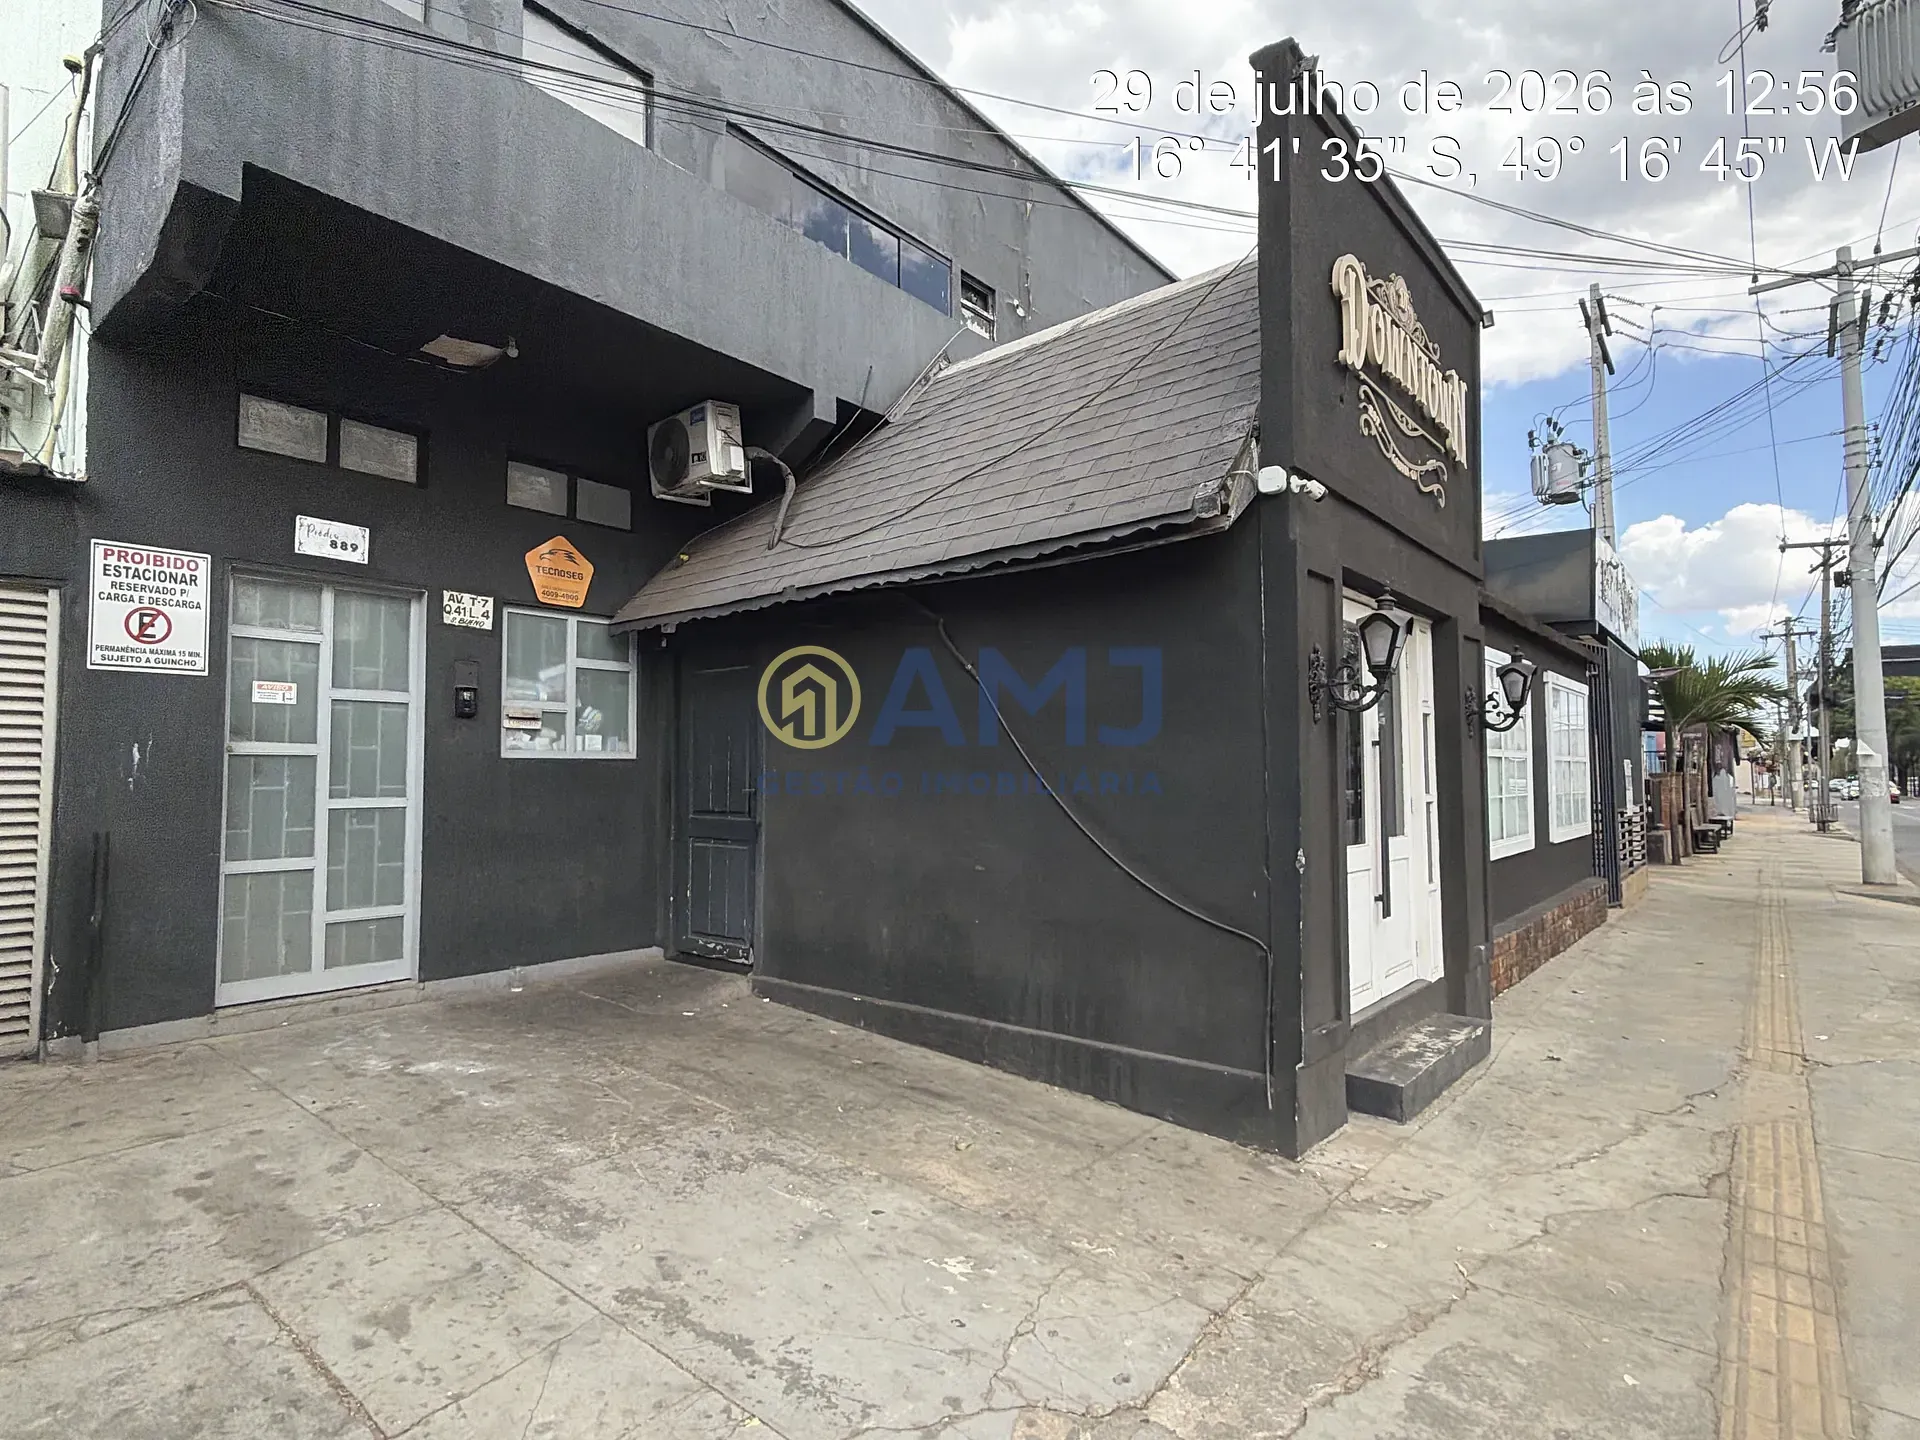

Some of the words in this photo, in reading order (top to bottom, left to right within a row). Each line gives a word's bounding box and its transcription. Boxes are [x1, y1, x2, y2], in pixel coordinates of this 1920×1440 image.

[329, 540, 359, 552] 889
[103, 548, 199, 571] PROIBIDO
[102, 564, 198, 587] ESTACIONAR
[110, 581, 177, 597] RESERVADO
[98, 591, 135, 603] CARGA
[138, 596, 145, 604] E
[148, 597, 201, 610] DESCARGA
[447, 593, 464, 604] AV.
[481, 609, 490, 620] 4
[458, 618, 485, 628] BUENO
[95, 644, 147, 655] PERMANÊNCIA
[149, 647, 176, 656] MÁXIMA
[100, 653, 142, 663] SUJEITO
[154, 657, 197, 667] GUINCHO
